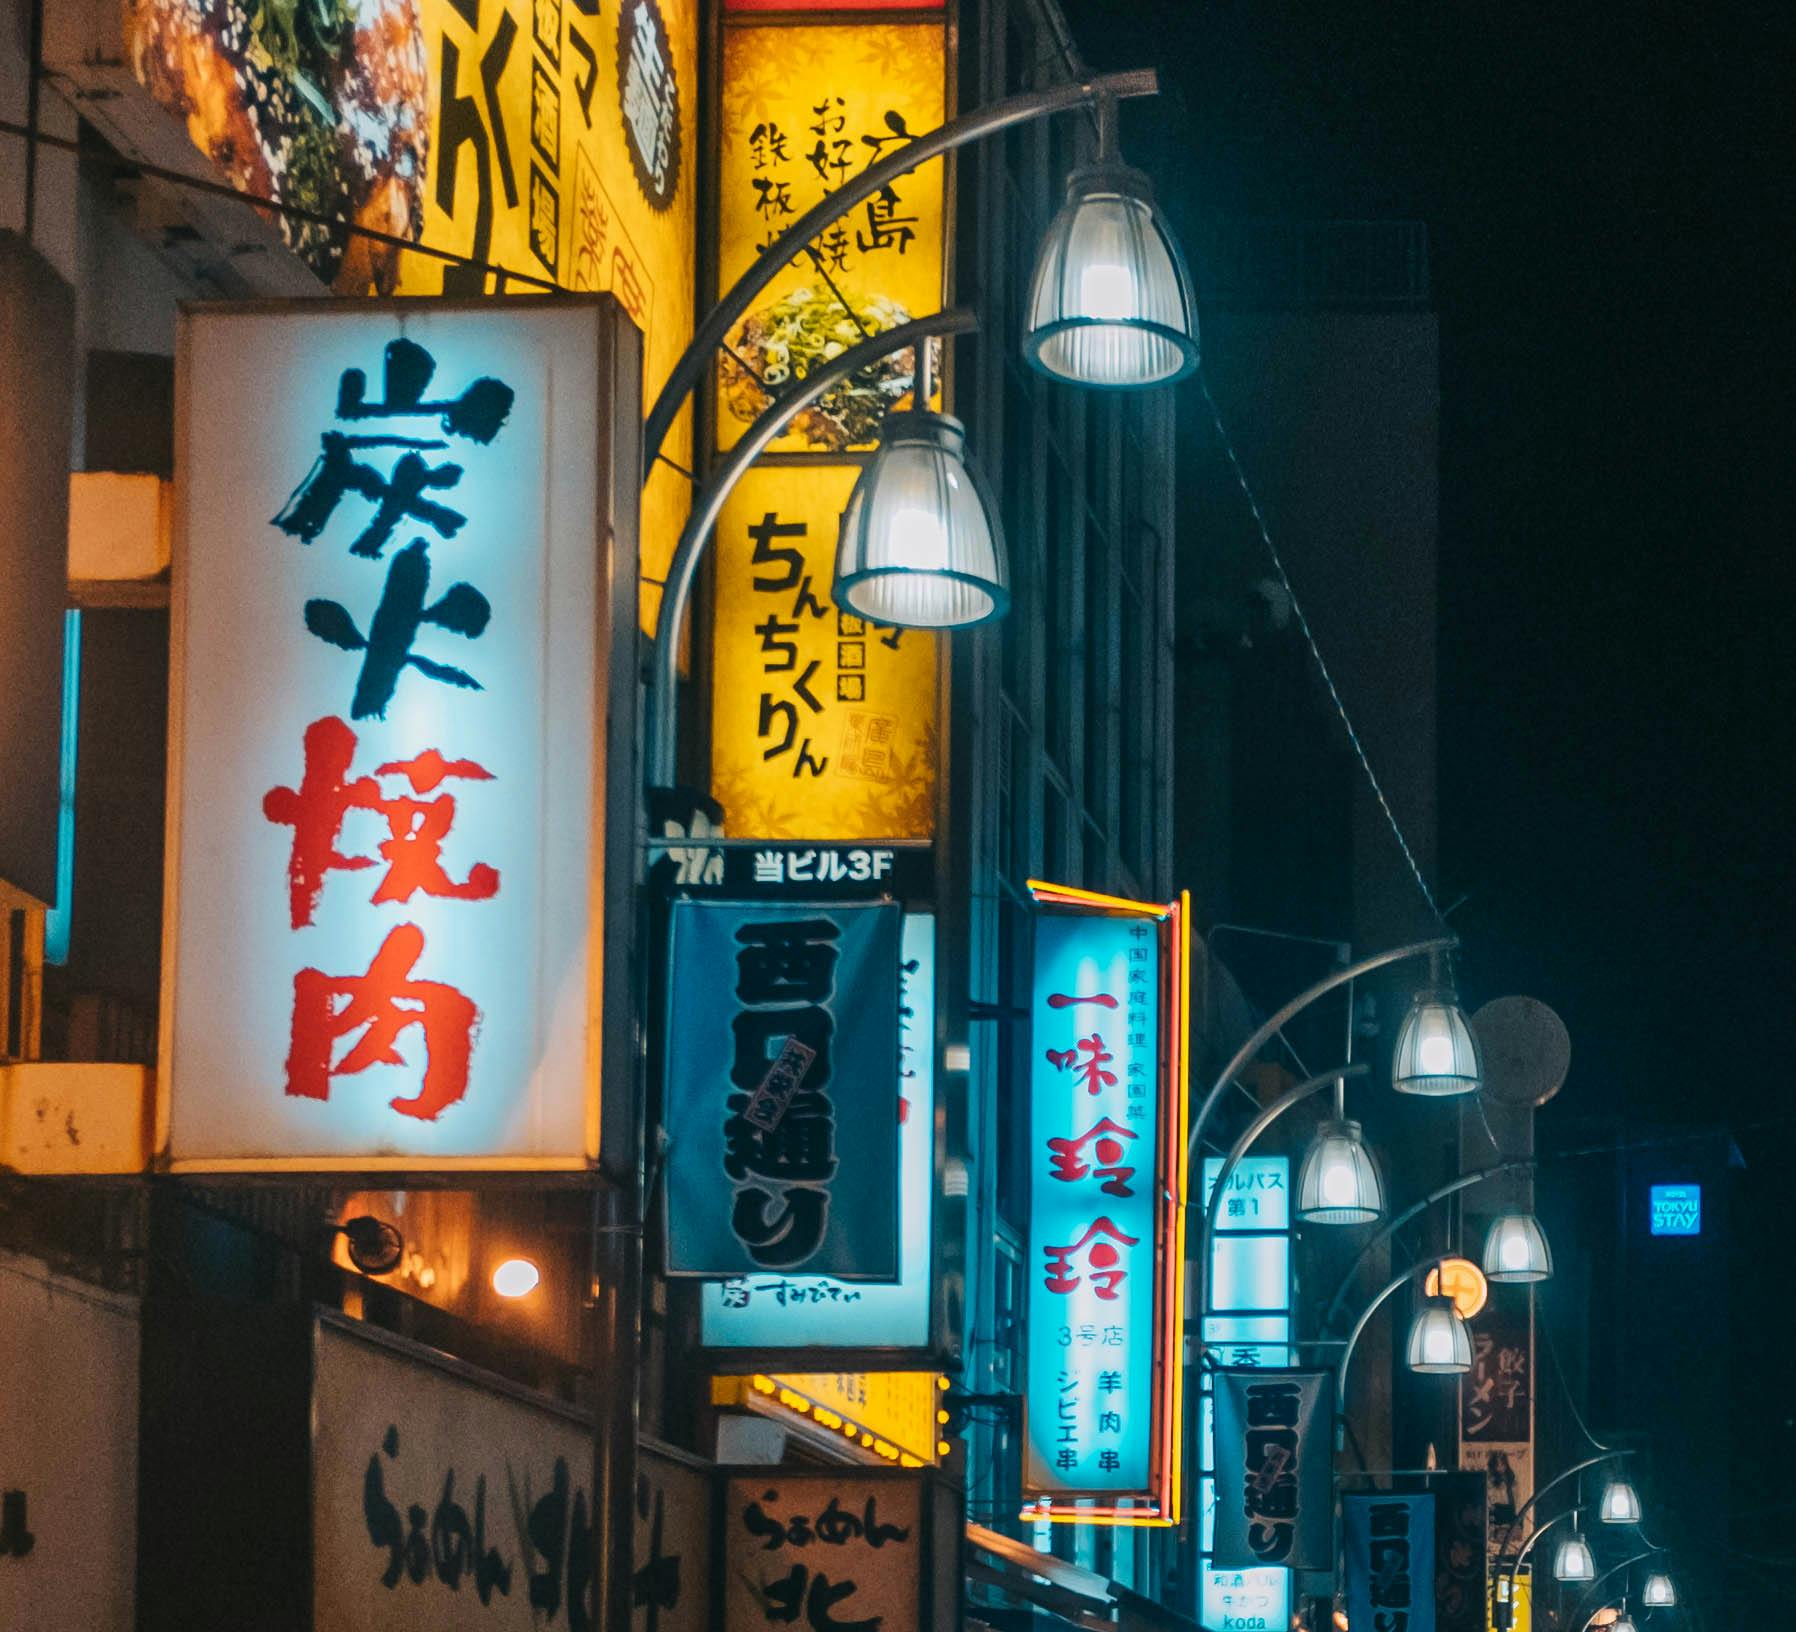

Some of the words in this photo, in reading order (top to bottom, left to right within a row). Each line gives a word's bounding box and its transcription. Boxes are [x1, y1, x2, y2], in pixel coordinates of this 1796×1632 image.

[806, 96, 854, 274] お好焼
[747, 511, 830, 780] ちんちくりん
[263, 337, 515, 1122] 炭火焼肉
[753, 849, 895, 884] 当ビル3F
[1042, 990, 1140, 1302] 一味玲玲
[1653, 1199, 1699, 1213] TOKYU
[1653, 1212, 1699, 1230] STAY
[1056, 1324, 1126, 1348] 3号店
[1497, 1346, 1527, 1411] 餃子
[1097, 1369, 1122, 1474] 羊肉串
[1466, 1332, 1495, 1437] ラーメン
[1223, 1614, 1267, 1630] koda
